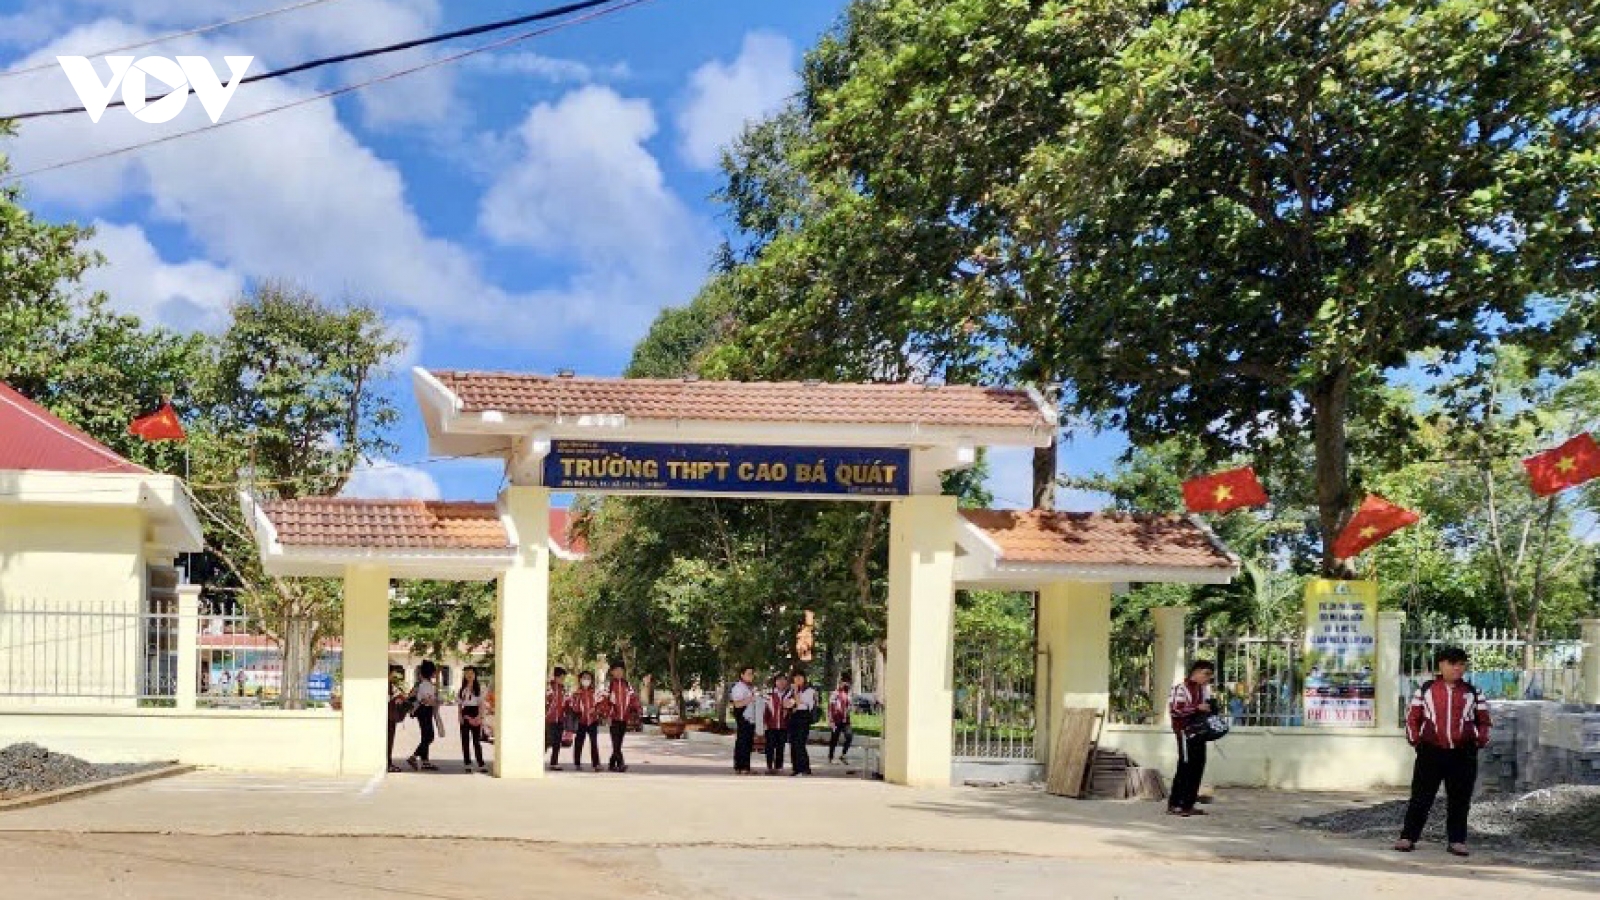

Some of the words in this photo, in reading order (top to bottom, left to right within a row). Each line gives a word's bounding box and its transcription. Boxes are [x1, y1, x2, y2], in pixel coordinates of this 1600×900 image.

[560, 452, 658, 479] TRƯỜNG
[667, 461, 730, 481] THPT
[738, 462, 788, 482] CAO
[795, 459, 827, 483] BÁ
[835, 459, 897, 487] QUÁT
